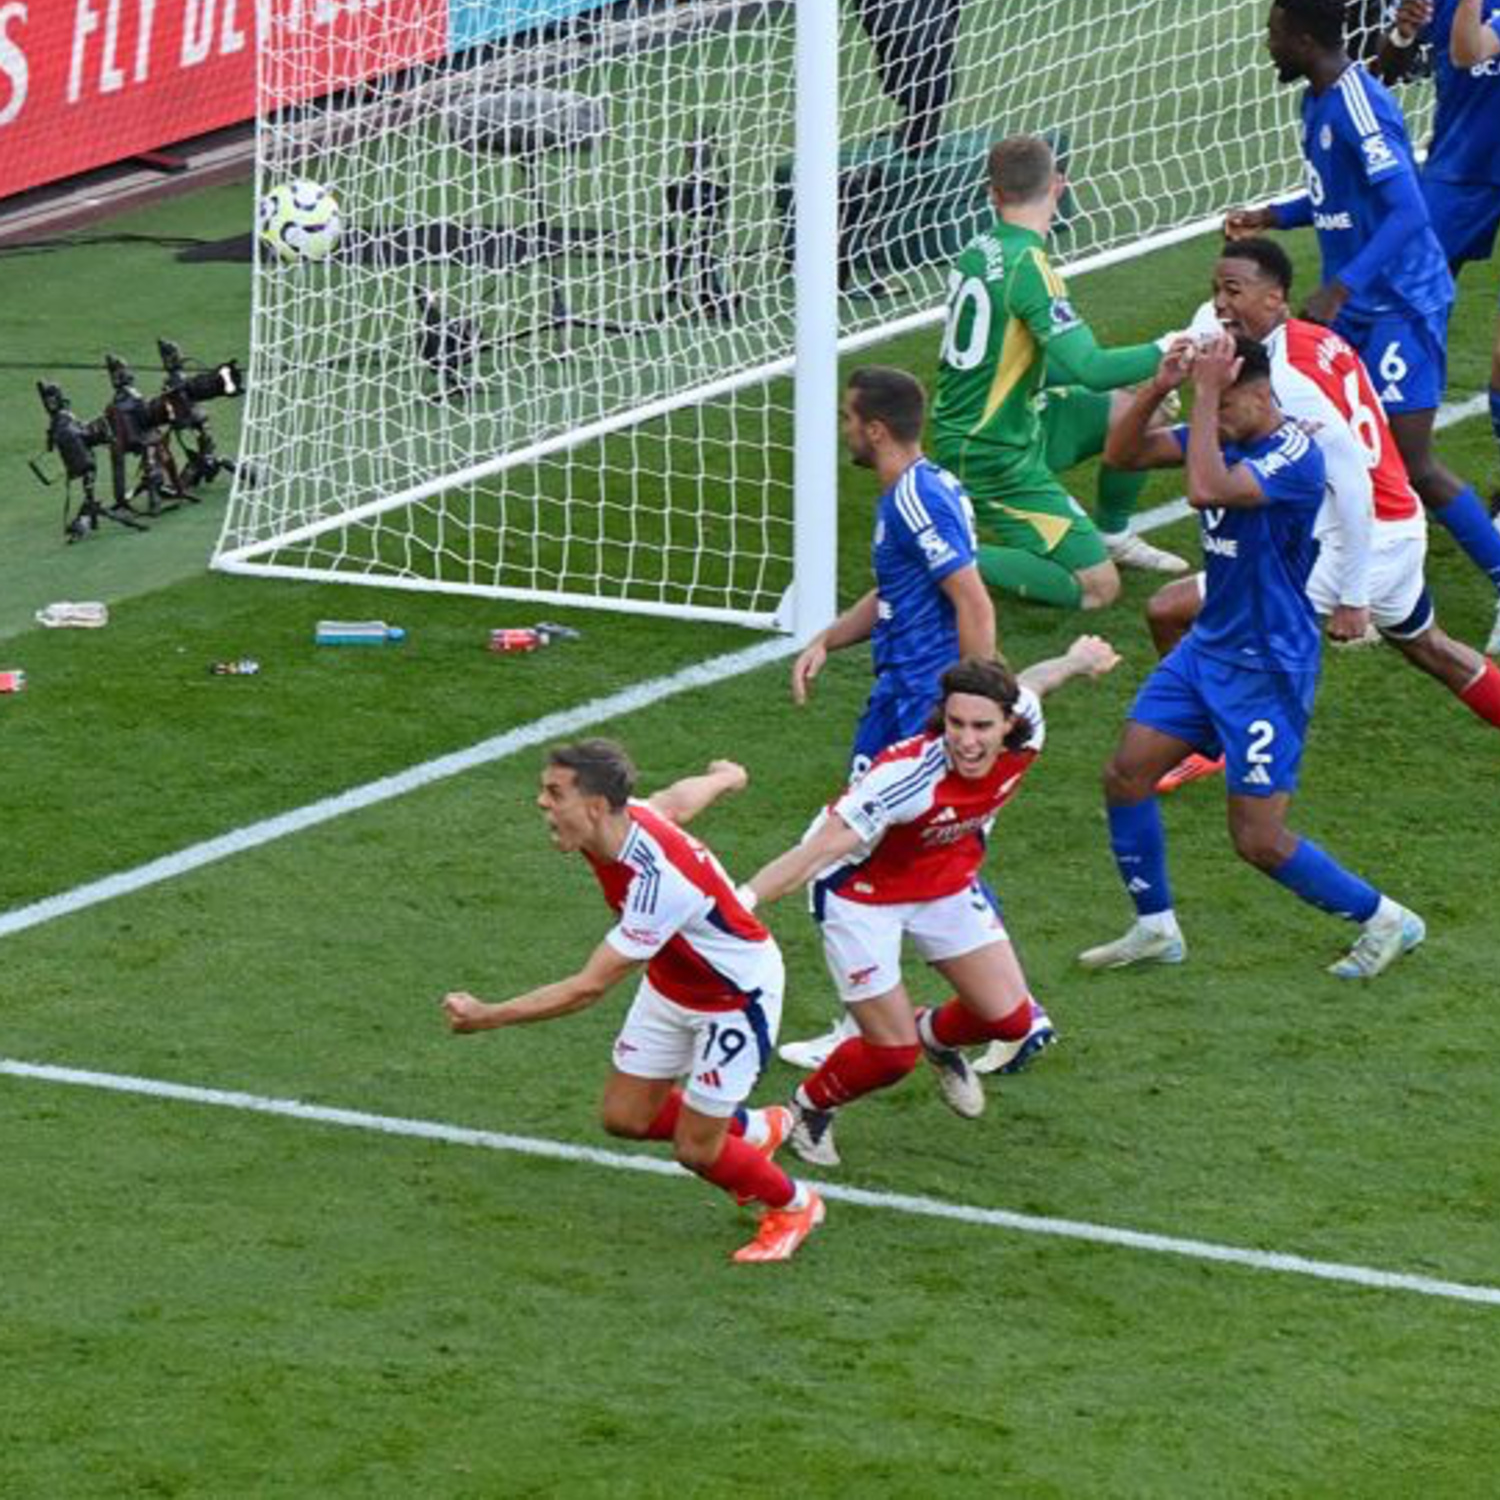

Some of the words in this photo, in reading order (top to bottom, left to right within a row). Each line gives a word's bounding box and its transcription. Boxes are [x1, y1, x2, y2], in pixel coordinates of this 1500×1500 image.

[1379, 341, 1407, 382] 6
[1247, 719, 1274, 763] 2
[702, 1022, 747, 1067] 19
